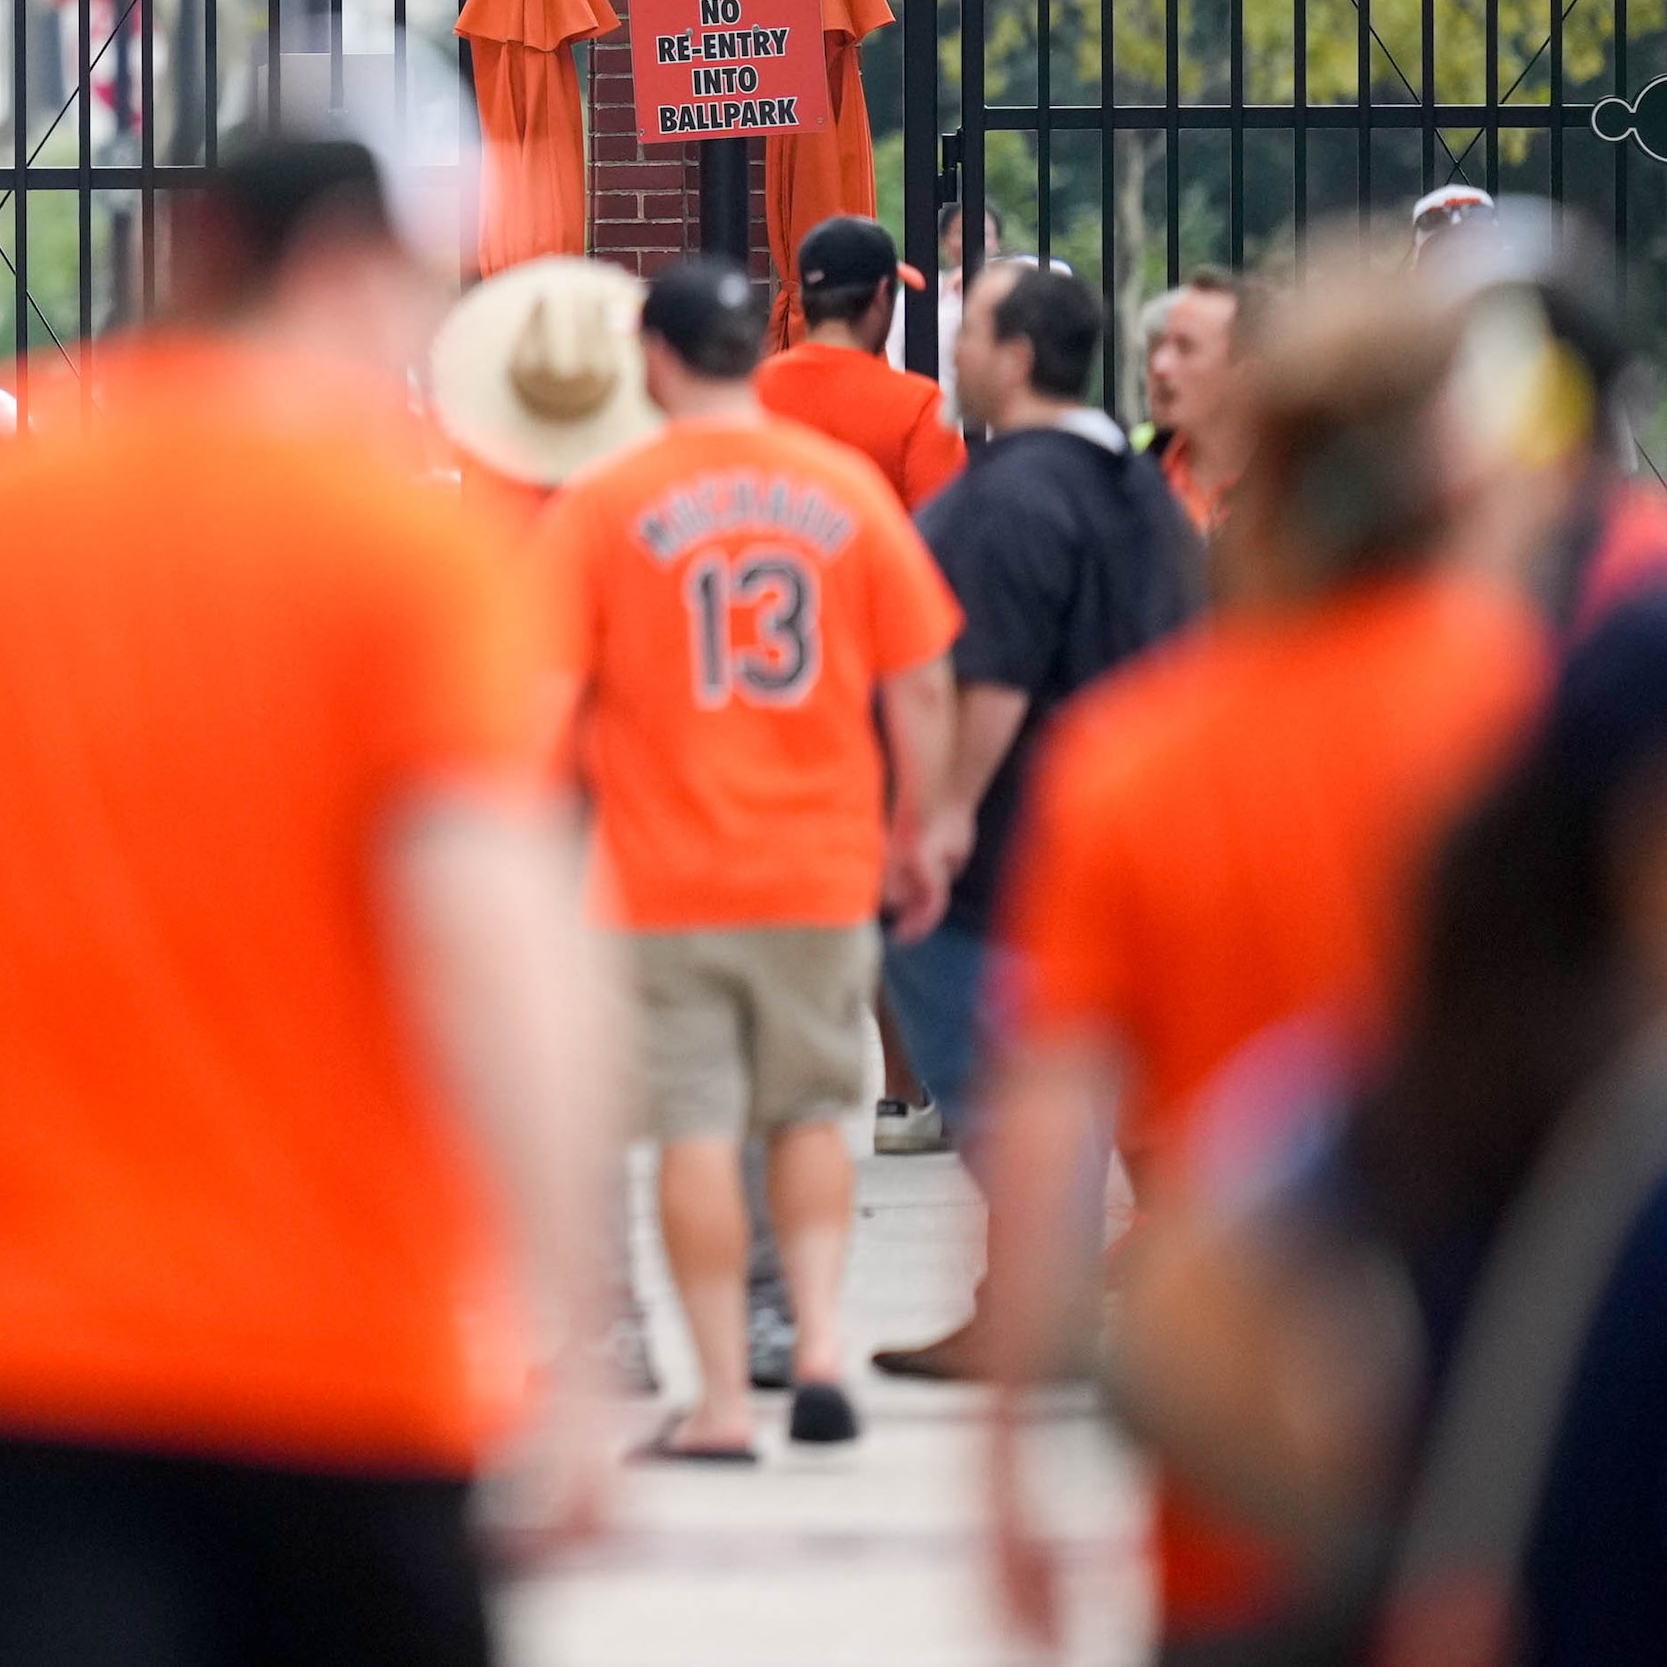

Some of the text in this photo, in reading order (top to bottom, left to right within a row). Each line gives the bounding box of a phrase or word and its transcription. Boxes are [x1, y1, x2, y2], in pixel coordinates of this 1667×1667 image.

[656, 27, 790, 64] RE-ENTRY
[693, 64, 759, 97] INTO
[658, 96, 799, 133] BALLPARK
[684, 546, 822, 709] 13
